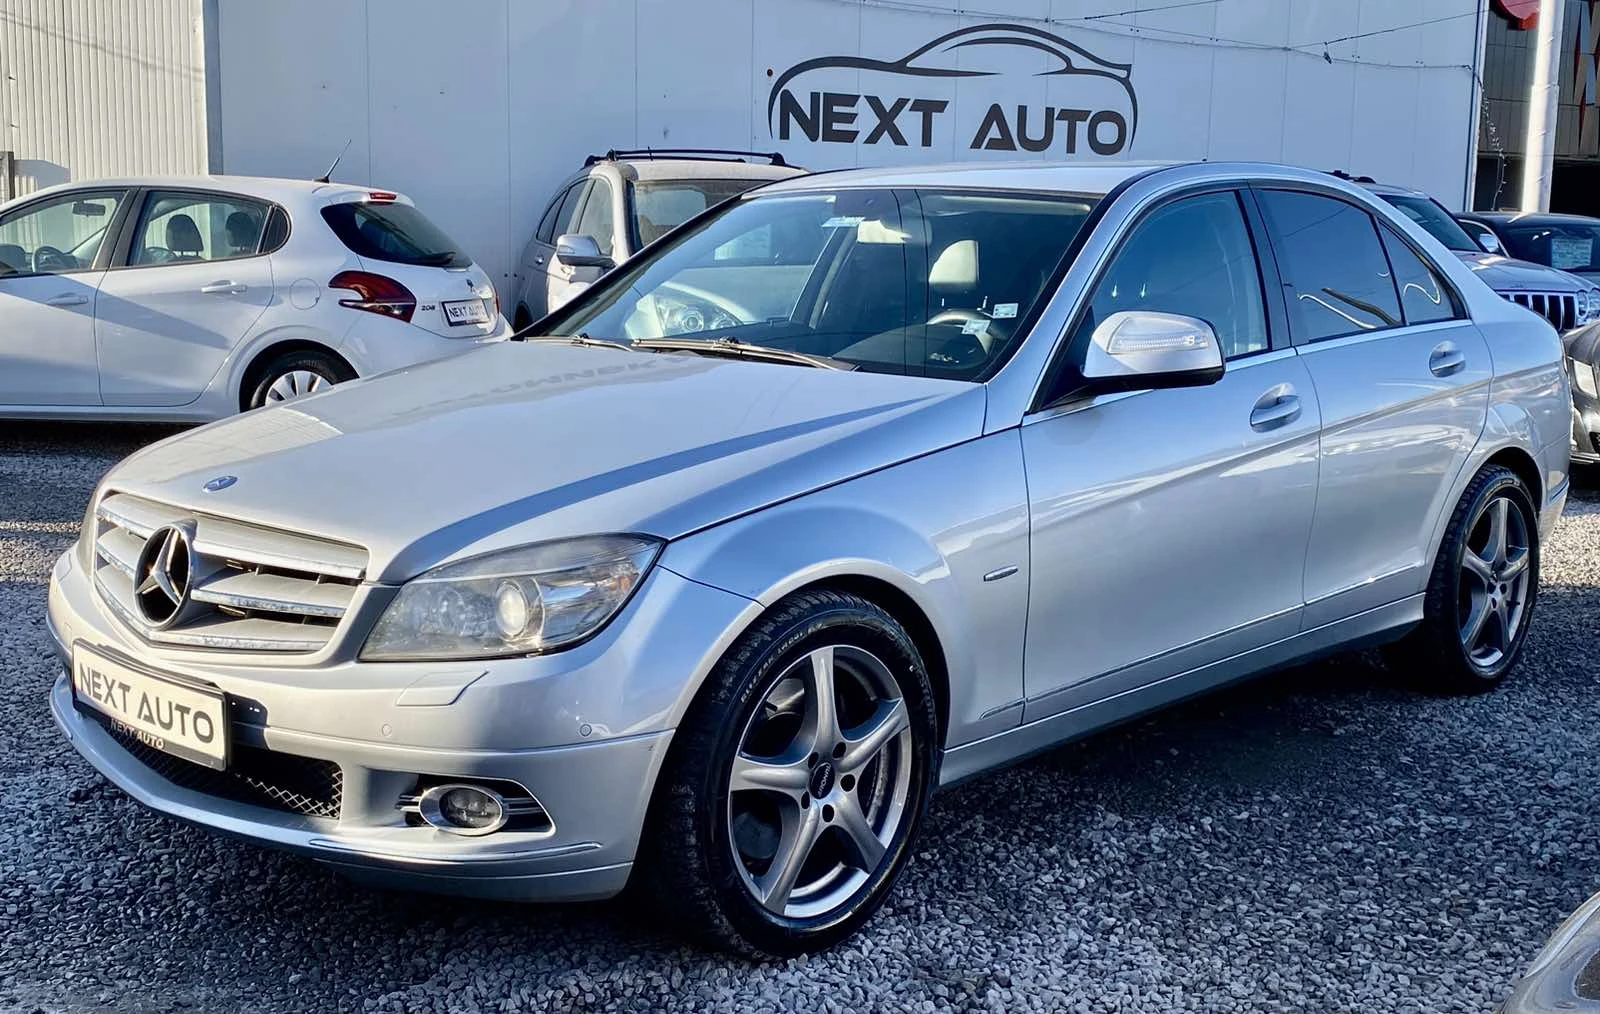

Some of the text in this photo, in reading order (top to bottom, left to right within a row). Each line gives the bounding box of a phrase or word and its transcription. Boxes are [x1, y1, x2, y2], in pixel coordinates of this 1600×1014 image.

[779, 89, 1127, 156] NEXT AUTO
[449, 306, 466, 317] NEXT
[79, 662, 214, 743] NEXT AUTO
[110, 719, 165, 750] NEXT AUTO
